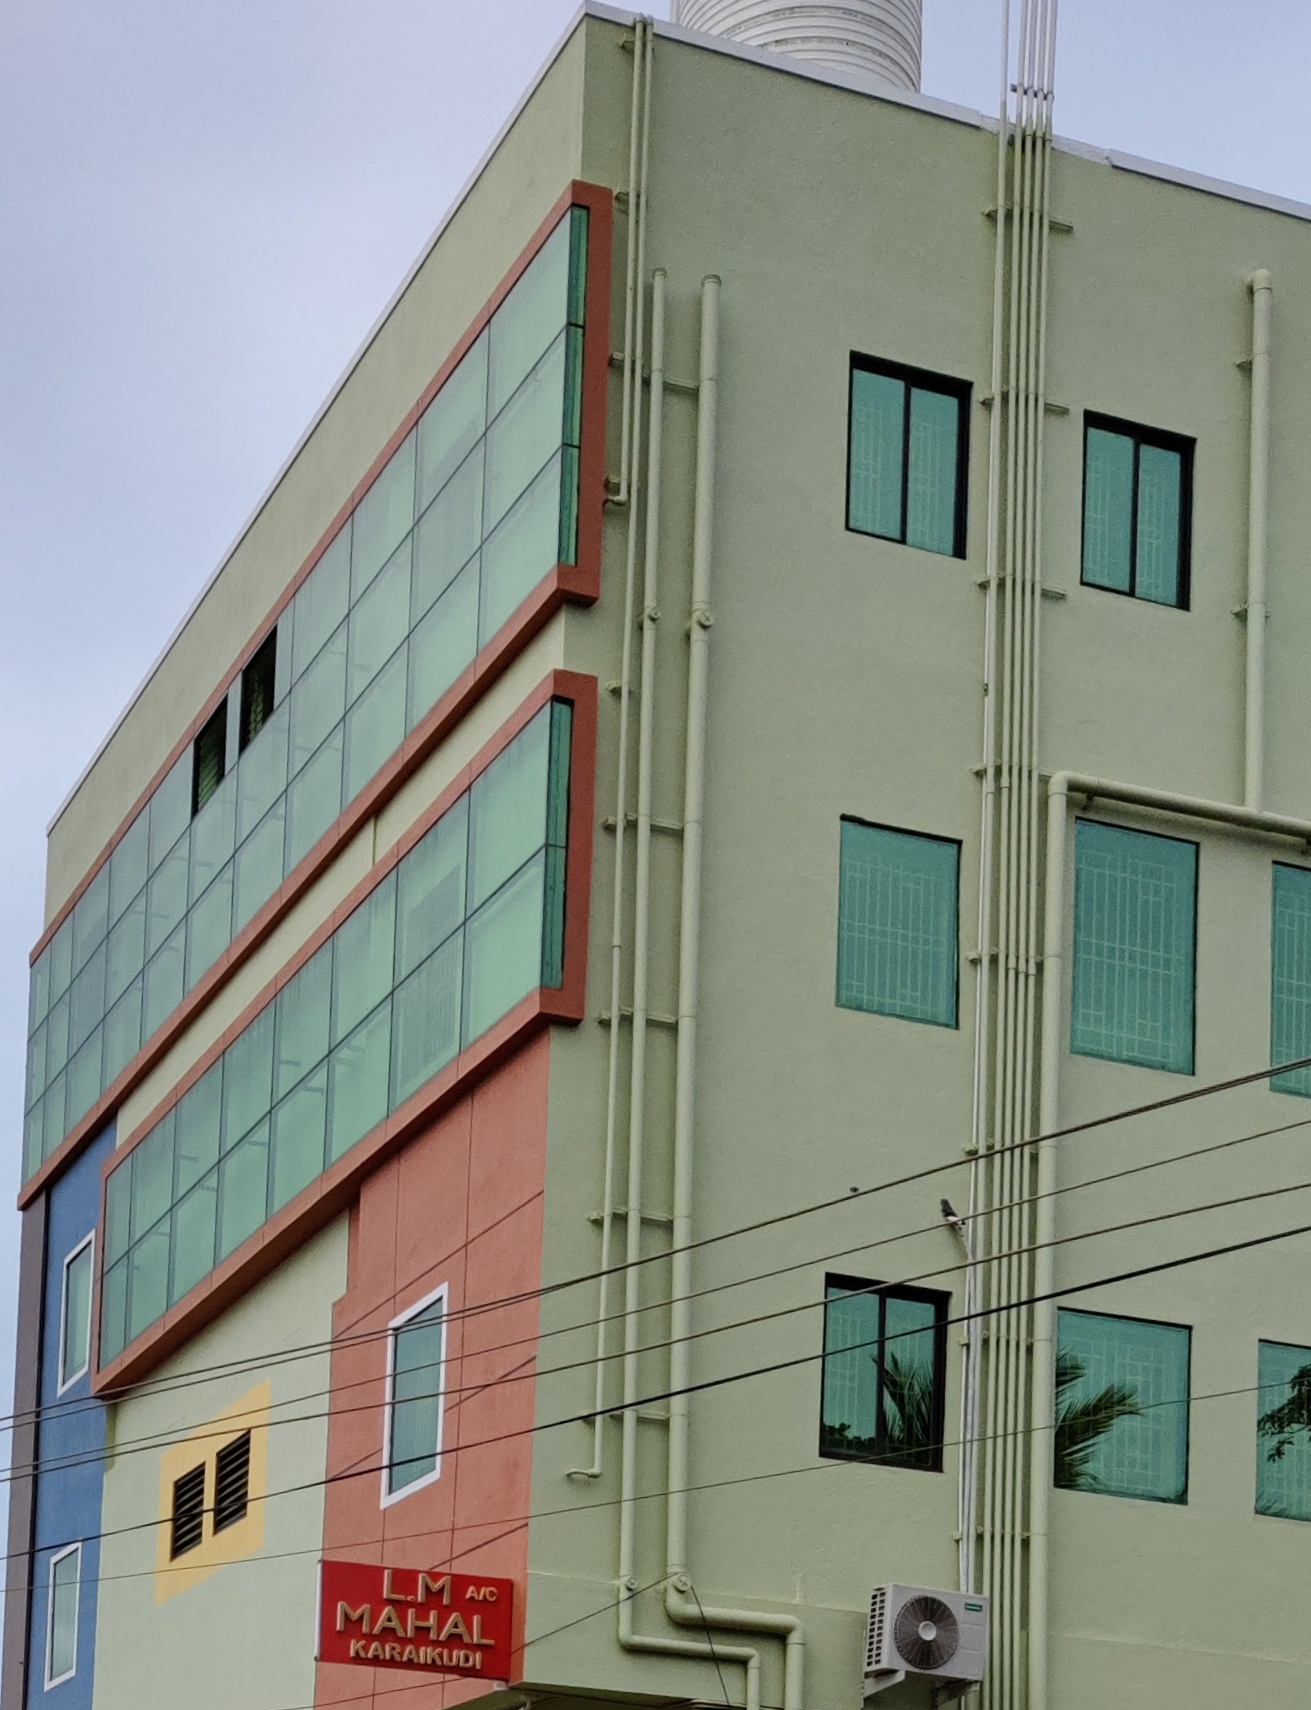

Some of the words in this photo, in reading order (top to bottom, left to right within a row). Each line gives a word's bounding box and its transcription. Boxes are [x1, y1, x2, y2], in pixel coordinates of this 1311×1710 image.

[465, 1585, 498, 1602] A/C
[335, 1601, 495, 1646] MAHAL
[349, 1638, 483, 1670] KARAIKUDI
